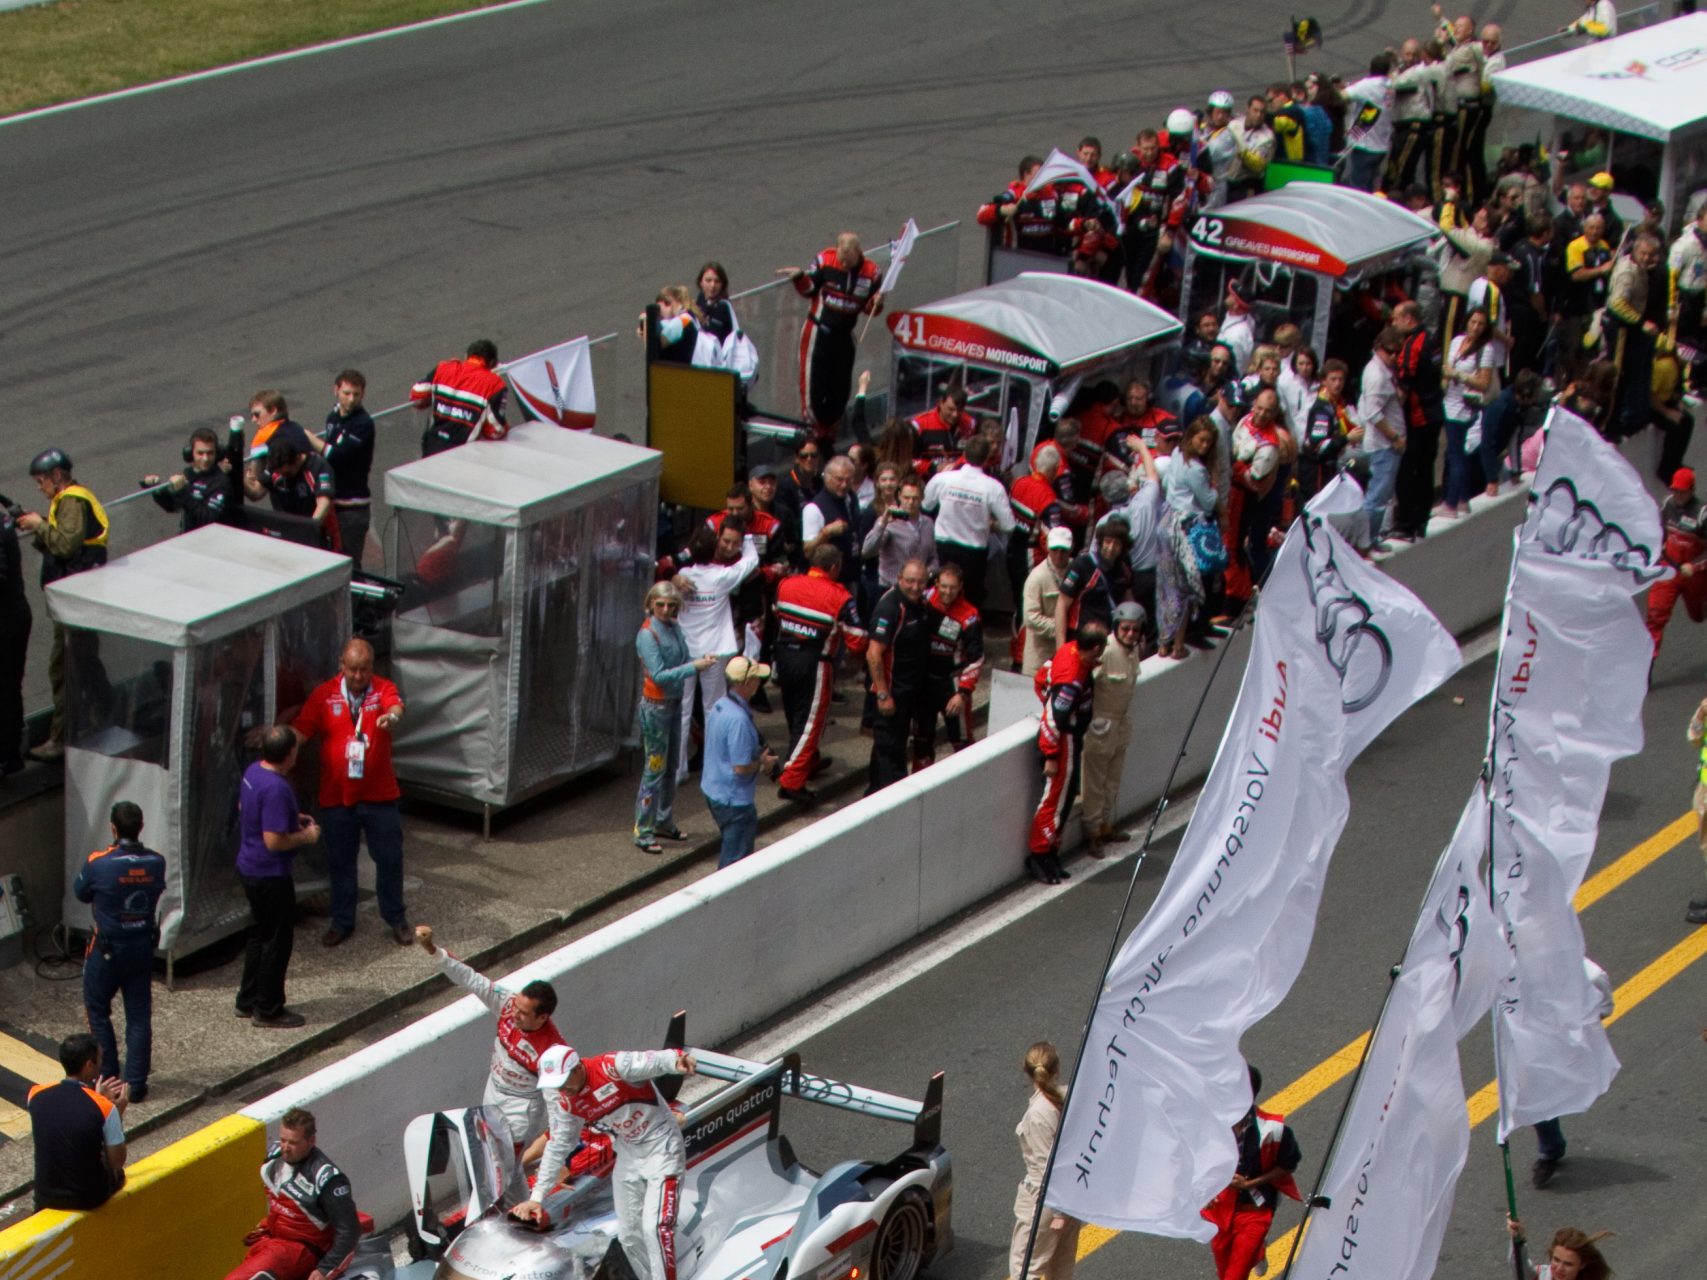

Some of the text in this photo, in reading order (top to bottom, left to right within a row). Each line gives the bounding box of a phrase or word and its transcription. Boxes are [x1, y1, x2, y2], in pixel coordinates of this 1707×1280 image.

[1191, 216, 1321, 265] 42 GREAVES MOTORSPORT
[894, 313, 1048, 373] 41 GREAVES MOTORSPORT
[780, 619, 818, 637] NISSAN
[684, 1117, 724, 1149] e-tron
[726, 1085, 775, 1125] quattro
